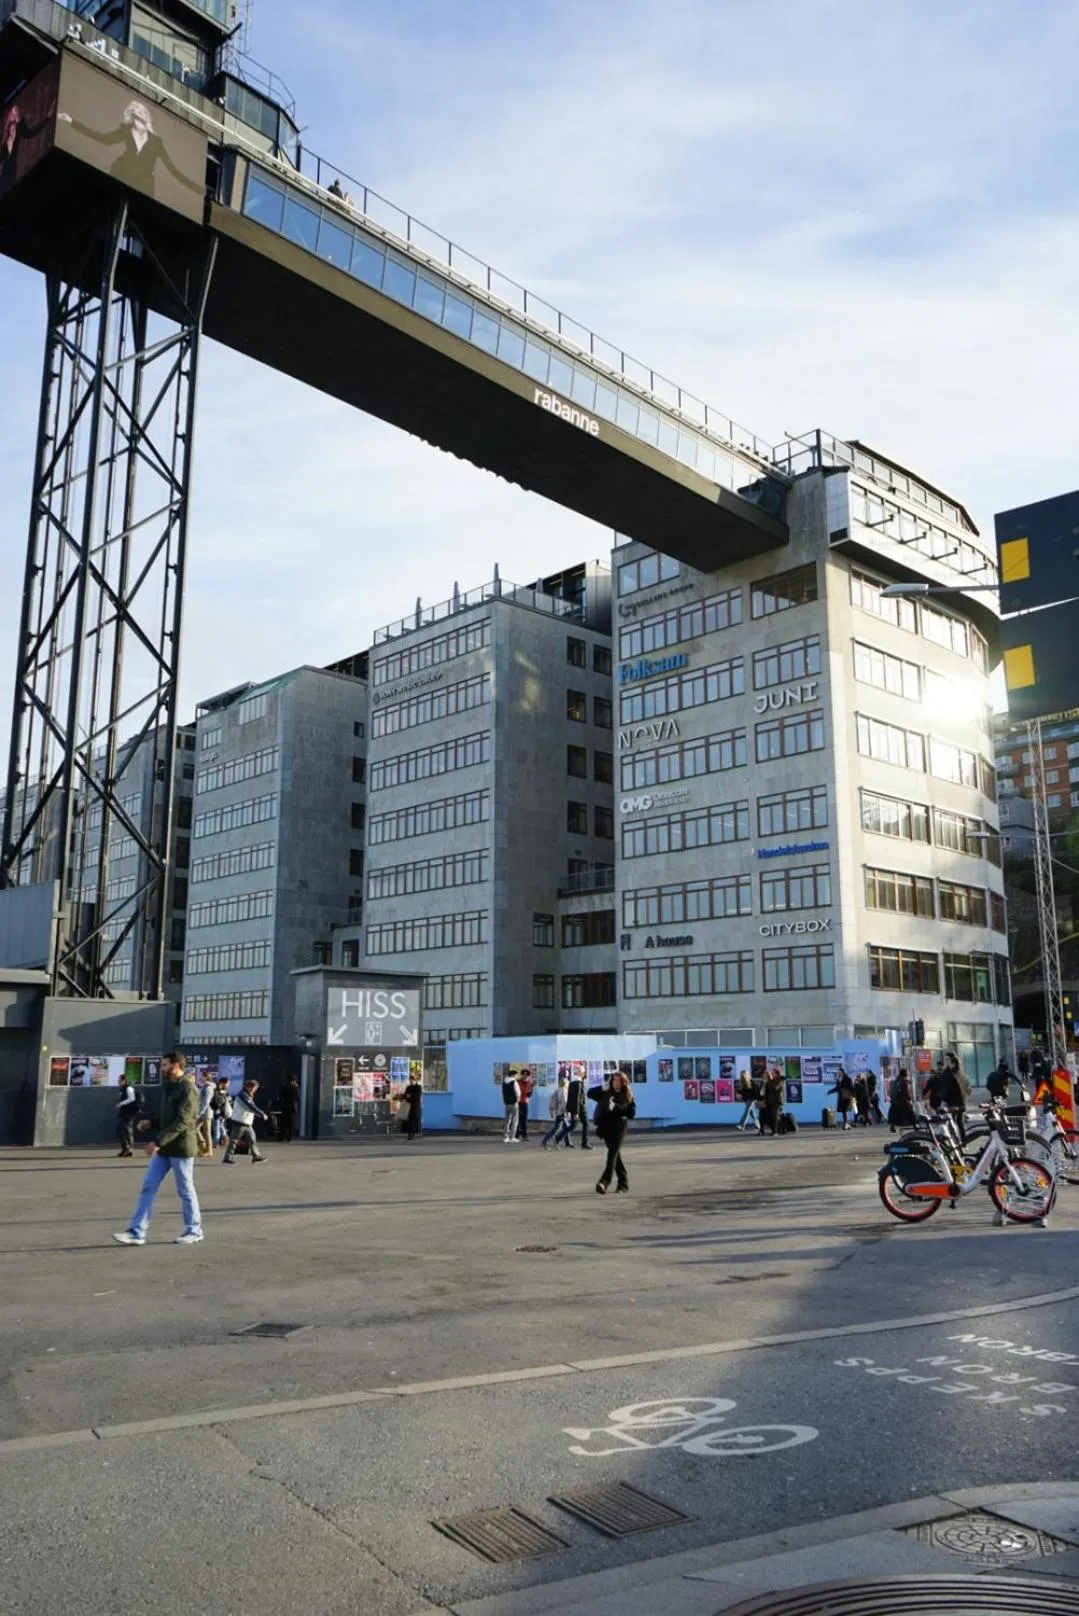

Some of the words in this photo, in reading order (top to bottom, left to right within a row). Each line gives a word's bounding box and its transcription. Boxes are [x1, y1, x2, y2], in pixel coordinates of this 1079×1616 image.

[534, 387, 600, 437] rabanne
[619, 652, 689, 686] Folksam
[753, 681, 819, 714] JUNI
[617, 718, 681, 752] NOVA
[657, 933, 694, 948] house
[759, 918, 832, 938] CITYBOX
[341, 990, 407, 1019] HISS
